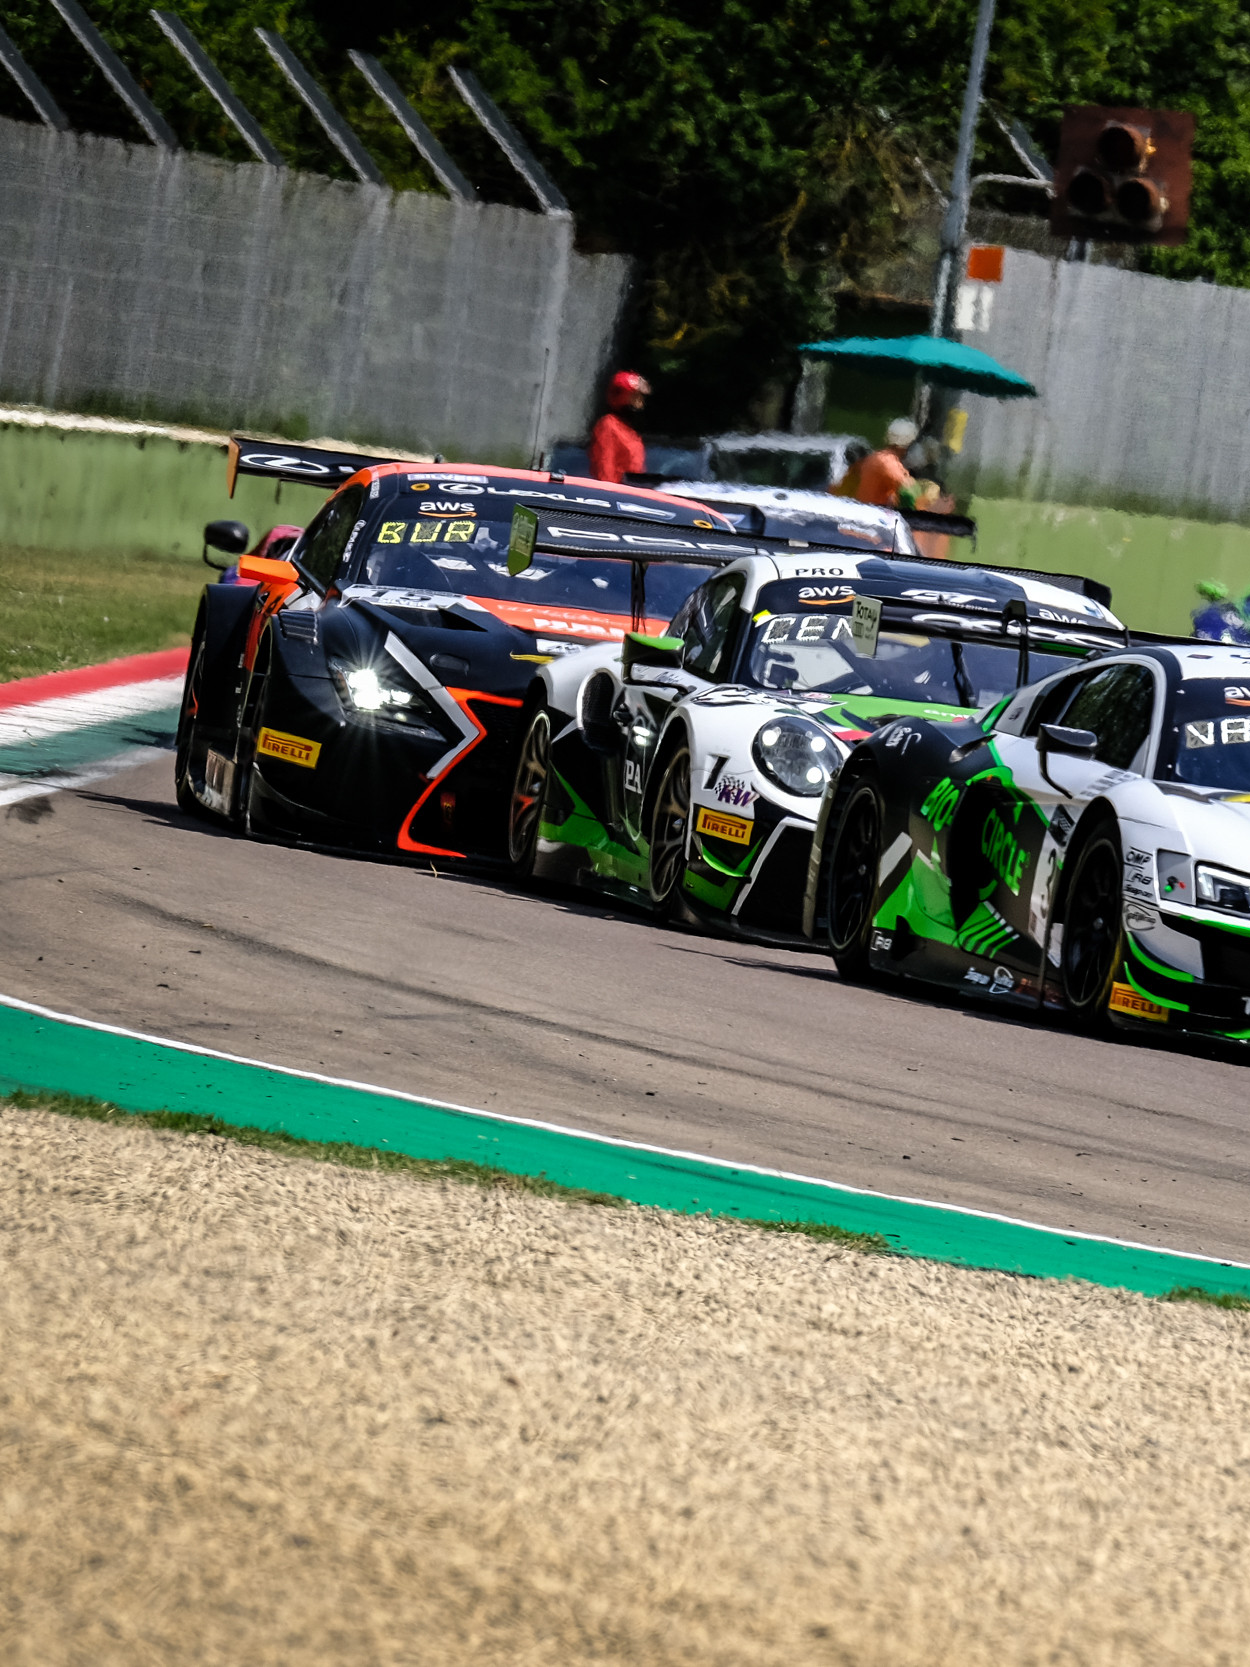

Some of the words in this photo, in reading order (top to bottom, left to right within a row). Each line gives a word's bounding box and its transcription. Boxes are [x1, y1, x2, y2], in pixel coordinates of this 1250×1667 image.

[419, 501, 475, 512] aws
[487, 486, 612, 508] LEXUS
[377, 520, 477, 544] BUR
[795, 567, 844, 577] PRO
[798, 585, 856, 598] aws
[262, 733, 313, 761] PIRELLI
[701, 813, 748, 839] PIRELLI
[981, 808, 1027, 897] CIRCLE
[1126, 851, 1151, 864] OMP
